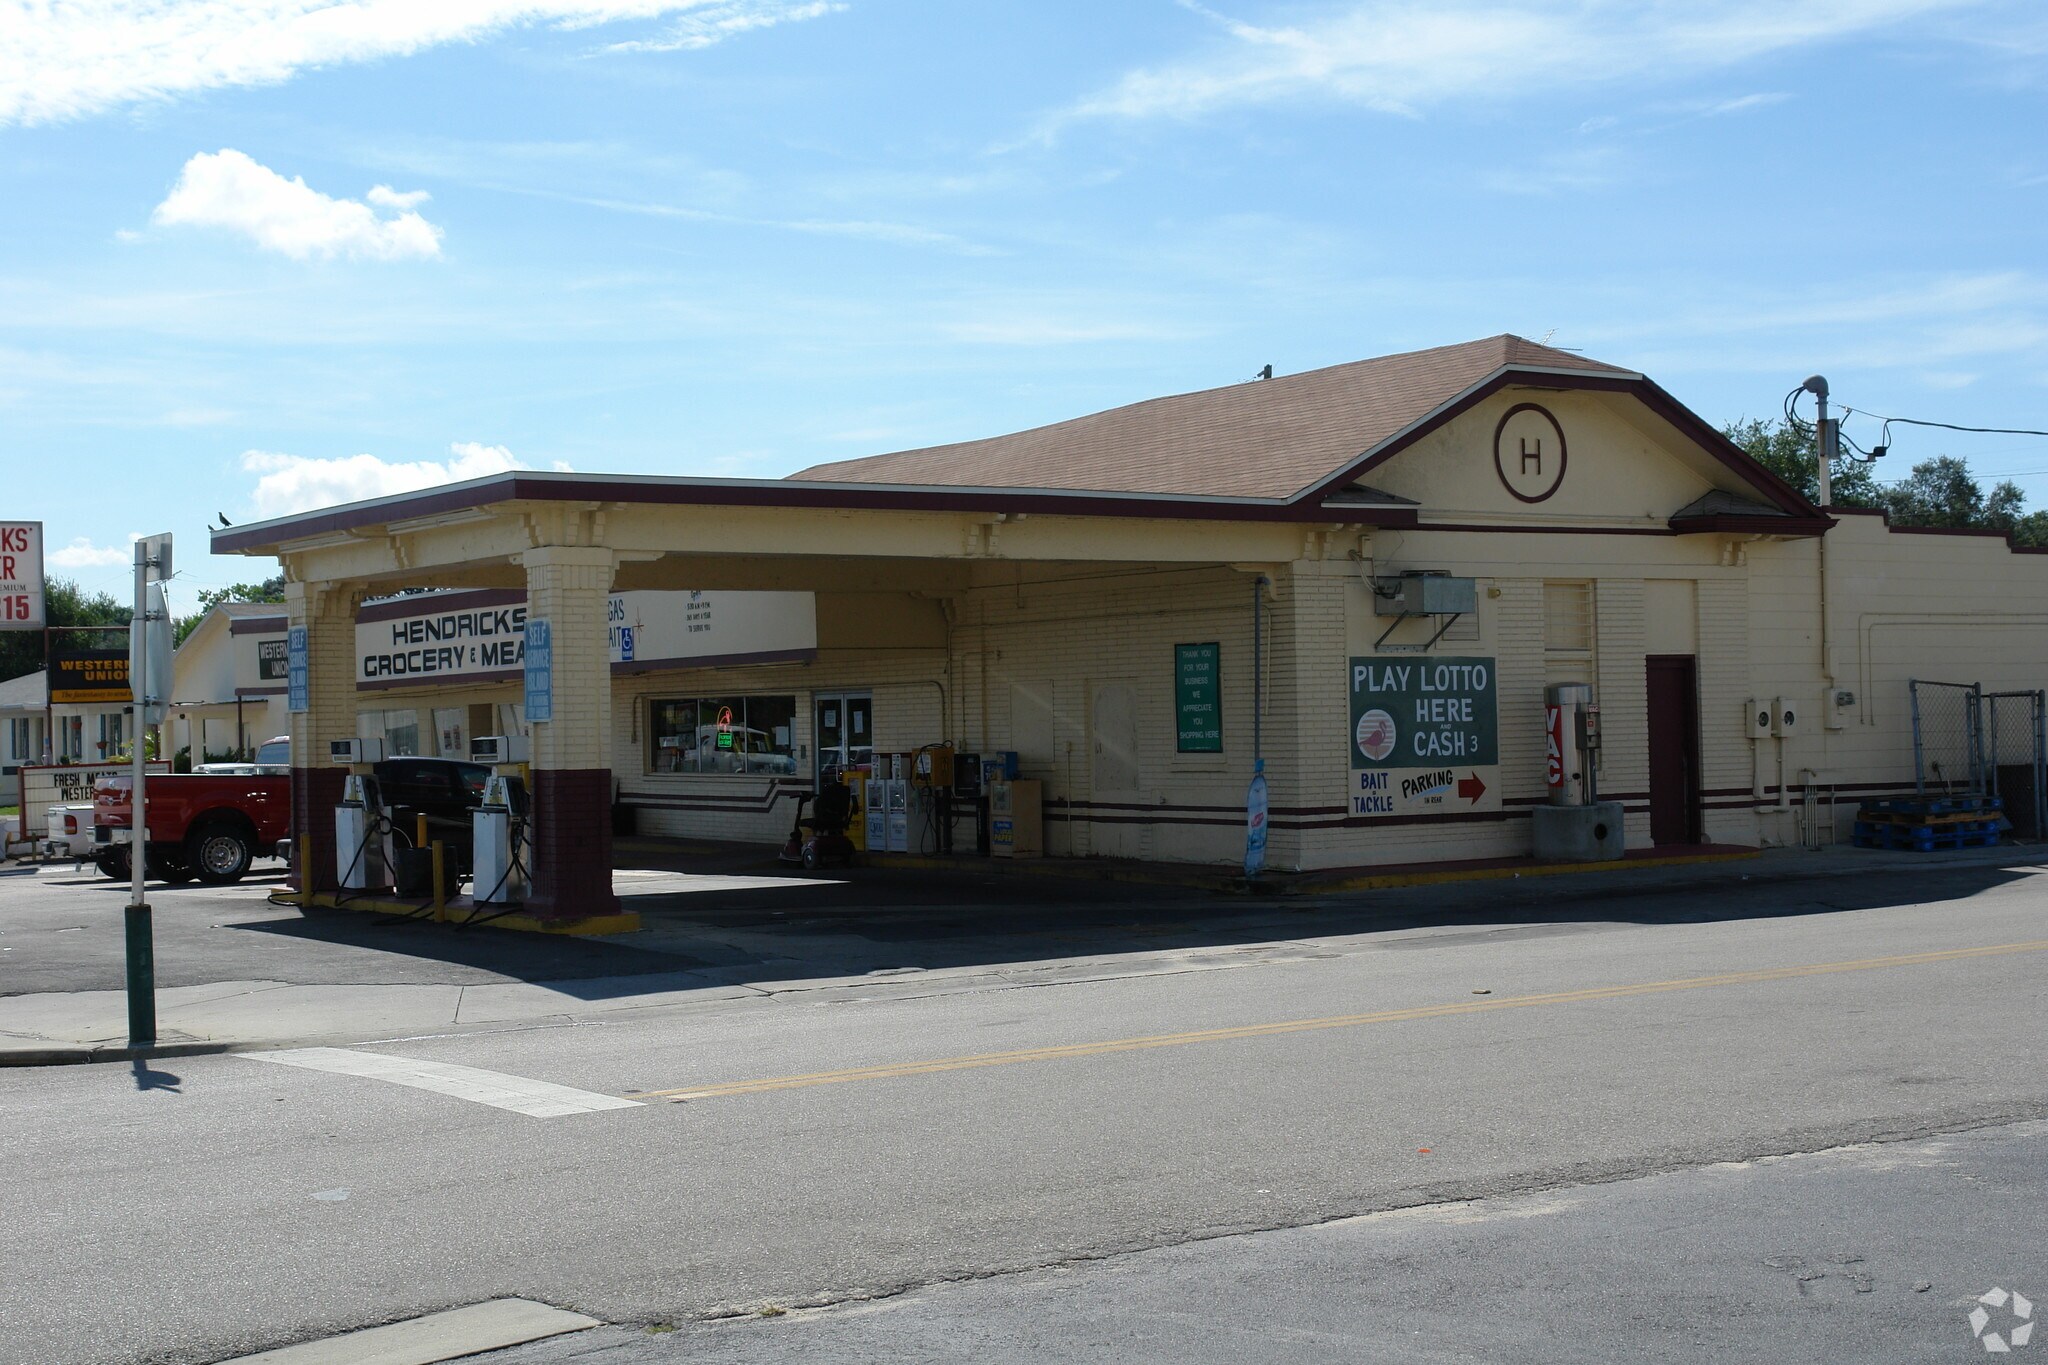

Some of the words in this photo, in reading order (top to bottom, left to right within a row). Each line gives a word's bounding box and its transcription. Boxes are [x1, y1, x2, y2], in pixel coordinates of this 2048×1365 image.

[1520, 437, 1541, 475] H
[0, 595, 30, 620] 15
[392, 607, 527, 645] HENDRICKS
[291, 632, 304, 649] SELF
[529, 626, 546, 646] SELF
[364, 645, 465, 677] GROCERY
[1182, 650, 1199, 659] THANK
[1201, 649, 1211, 657] YOU
[1184, 664, 1194, 672] FOR
[1195, 663, 1209, 671] YOUR
[1184, 676, 1208, 685] BUSINESS
[1354, 665, 1411, 692] PLAY
[1420, 665, 1487, 691] LOTTO
[1192, 690, 1200, 699] WE
[1183, 703, 1212, 712] APPRECIATE
[1416, 698, 1473, 722] HERE
[1192, 717, 1203, 725] YOU
[1179, 731, 1204, 739] SHOPPING
[1205, 730, 1219, 738] HERE
[1413, 731, 1465, 756] CASH
[1470, 735, 1478, 753] 3
[54, 773, 80, 787] FRESH
[1361, 773, 1388, 790] BAIT
[1401, 769, 1453, 799] PARKING
[1353, 796, 1393, 813] TACKLE
[1430, 796, 1442, 804] REAR
